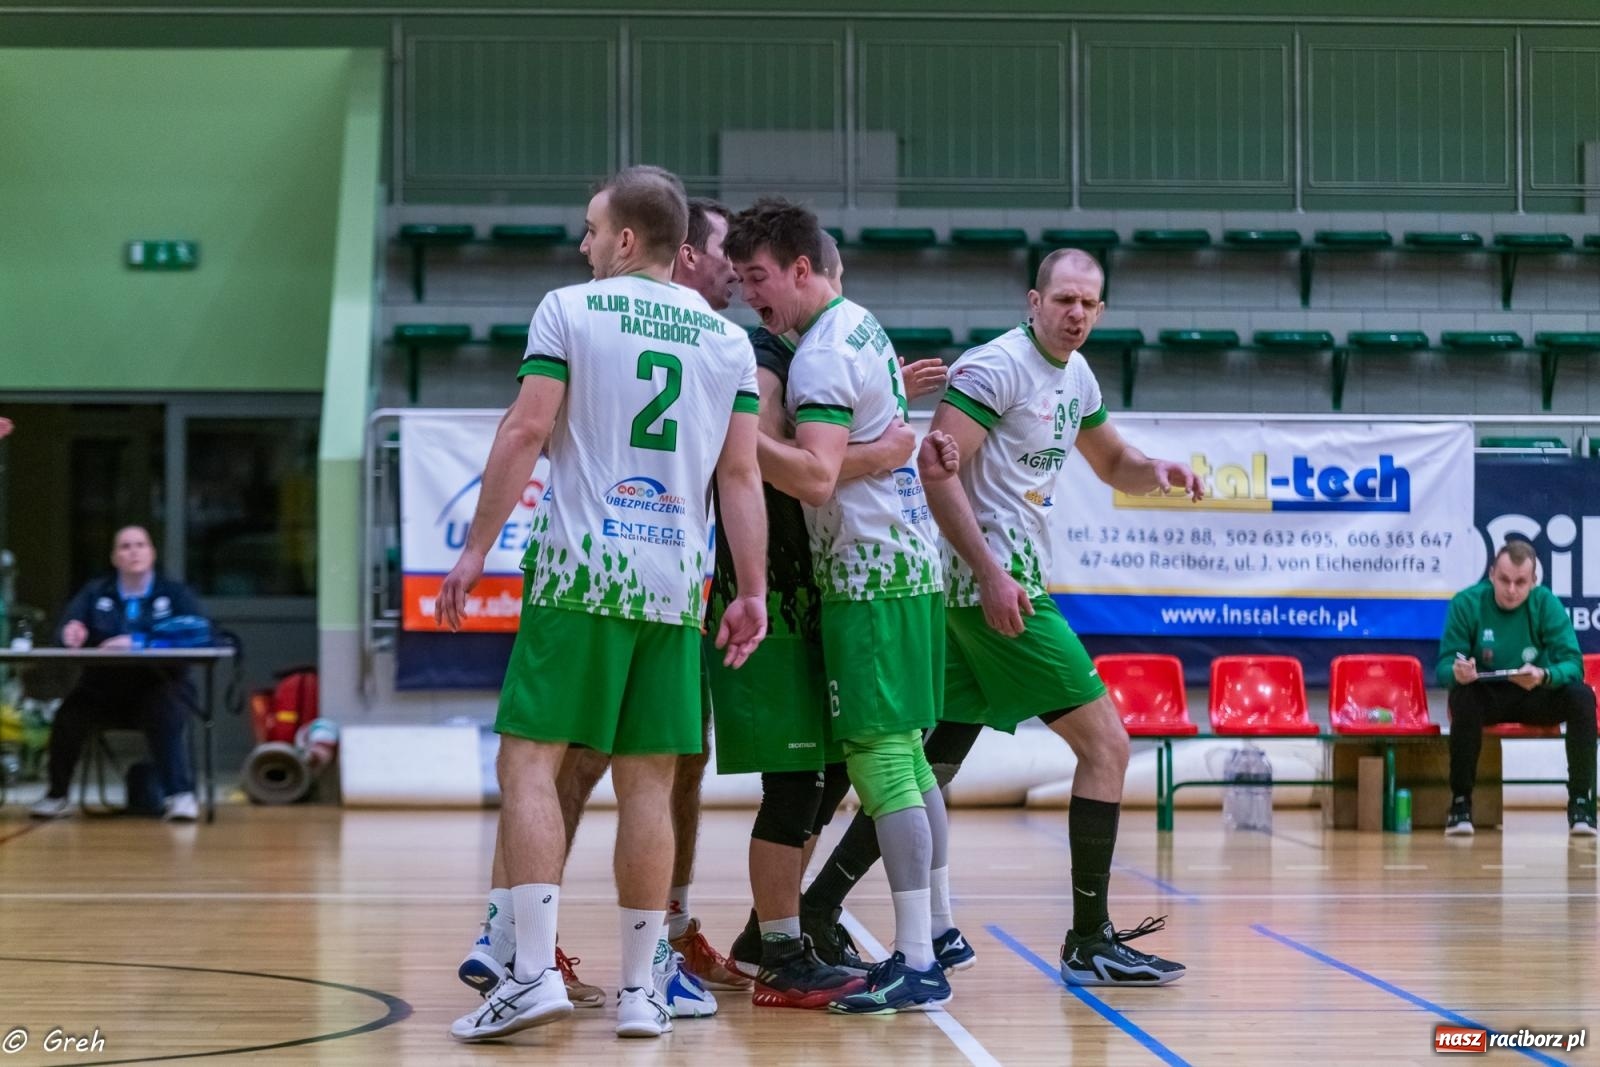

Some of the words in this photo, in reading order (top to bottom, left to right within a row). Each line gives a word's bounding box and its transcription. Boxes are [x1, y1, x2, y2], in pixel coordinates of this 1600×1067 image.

[586, 295, 629, 313] KLUB
[634, 299, 727, 336] SIATKARSKI
[621, 314, 700, 347] RACIBÓRZ
[630, 350, 682, 452] 2
[1116, 454, 1410, 503] tal-tech
[1164, 528, 1186, 545] 92
[1226, 529, 1257, 547] 502
[1263, 530, 1295, 547] 632
[1347, 531, 1380, 547] 606
[1420, 531, 1452, 549] 647
[1278, 558, 1311, 571] von
[1315, 555, 1425, 573] Eichendorffa
[1431, 556, 1441, 573] 2
[1161, 603, 1358, 632] www.instal-tech.pl
